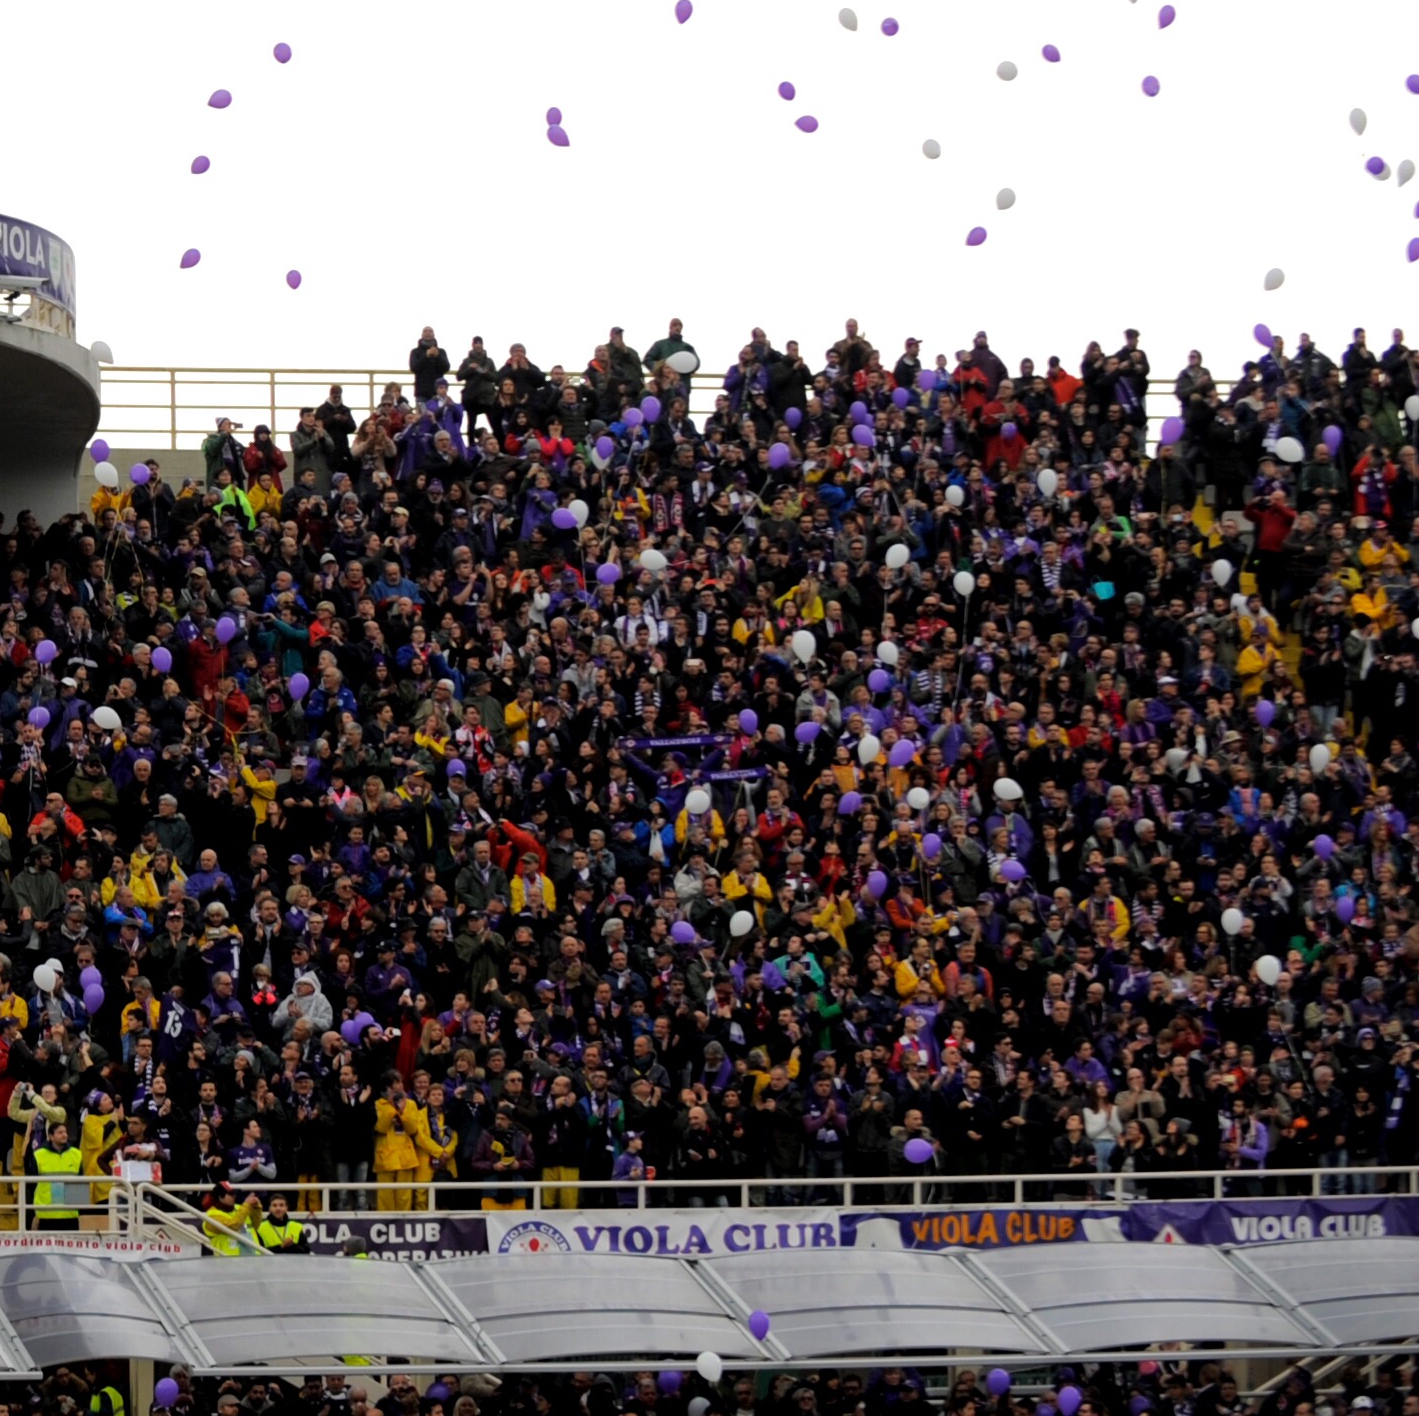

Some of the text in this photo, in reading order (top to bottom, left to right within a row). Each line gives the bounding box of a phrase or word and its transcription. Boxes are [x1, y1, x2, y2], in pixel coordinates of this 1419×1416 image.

[370, 1222, 441, 1244] CLUB
[573, 1224, 713, 1255] VIOLA
[723, 1221, 838, 1252] CLUB
[911, 1212, 1000, 1245] VIOLA
[1006, 1211, 1076, 1242] CLUB
[1230, 1214, 1386, 1241] VIOLA CLUB
[105, 1242, 143, 1251] viola
[149, 1242, 181, 1254] club
